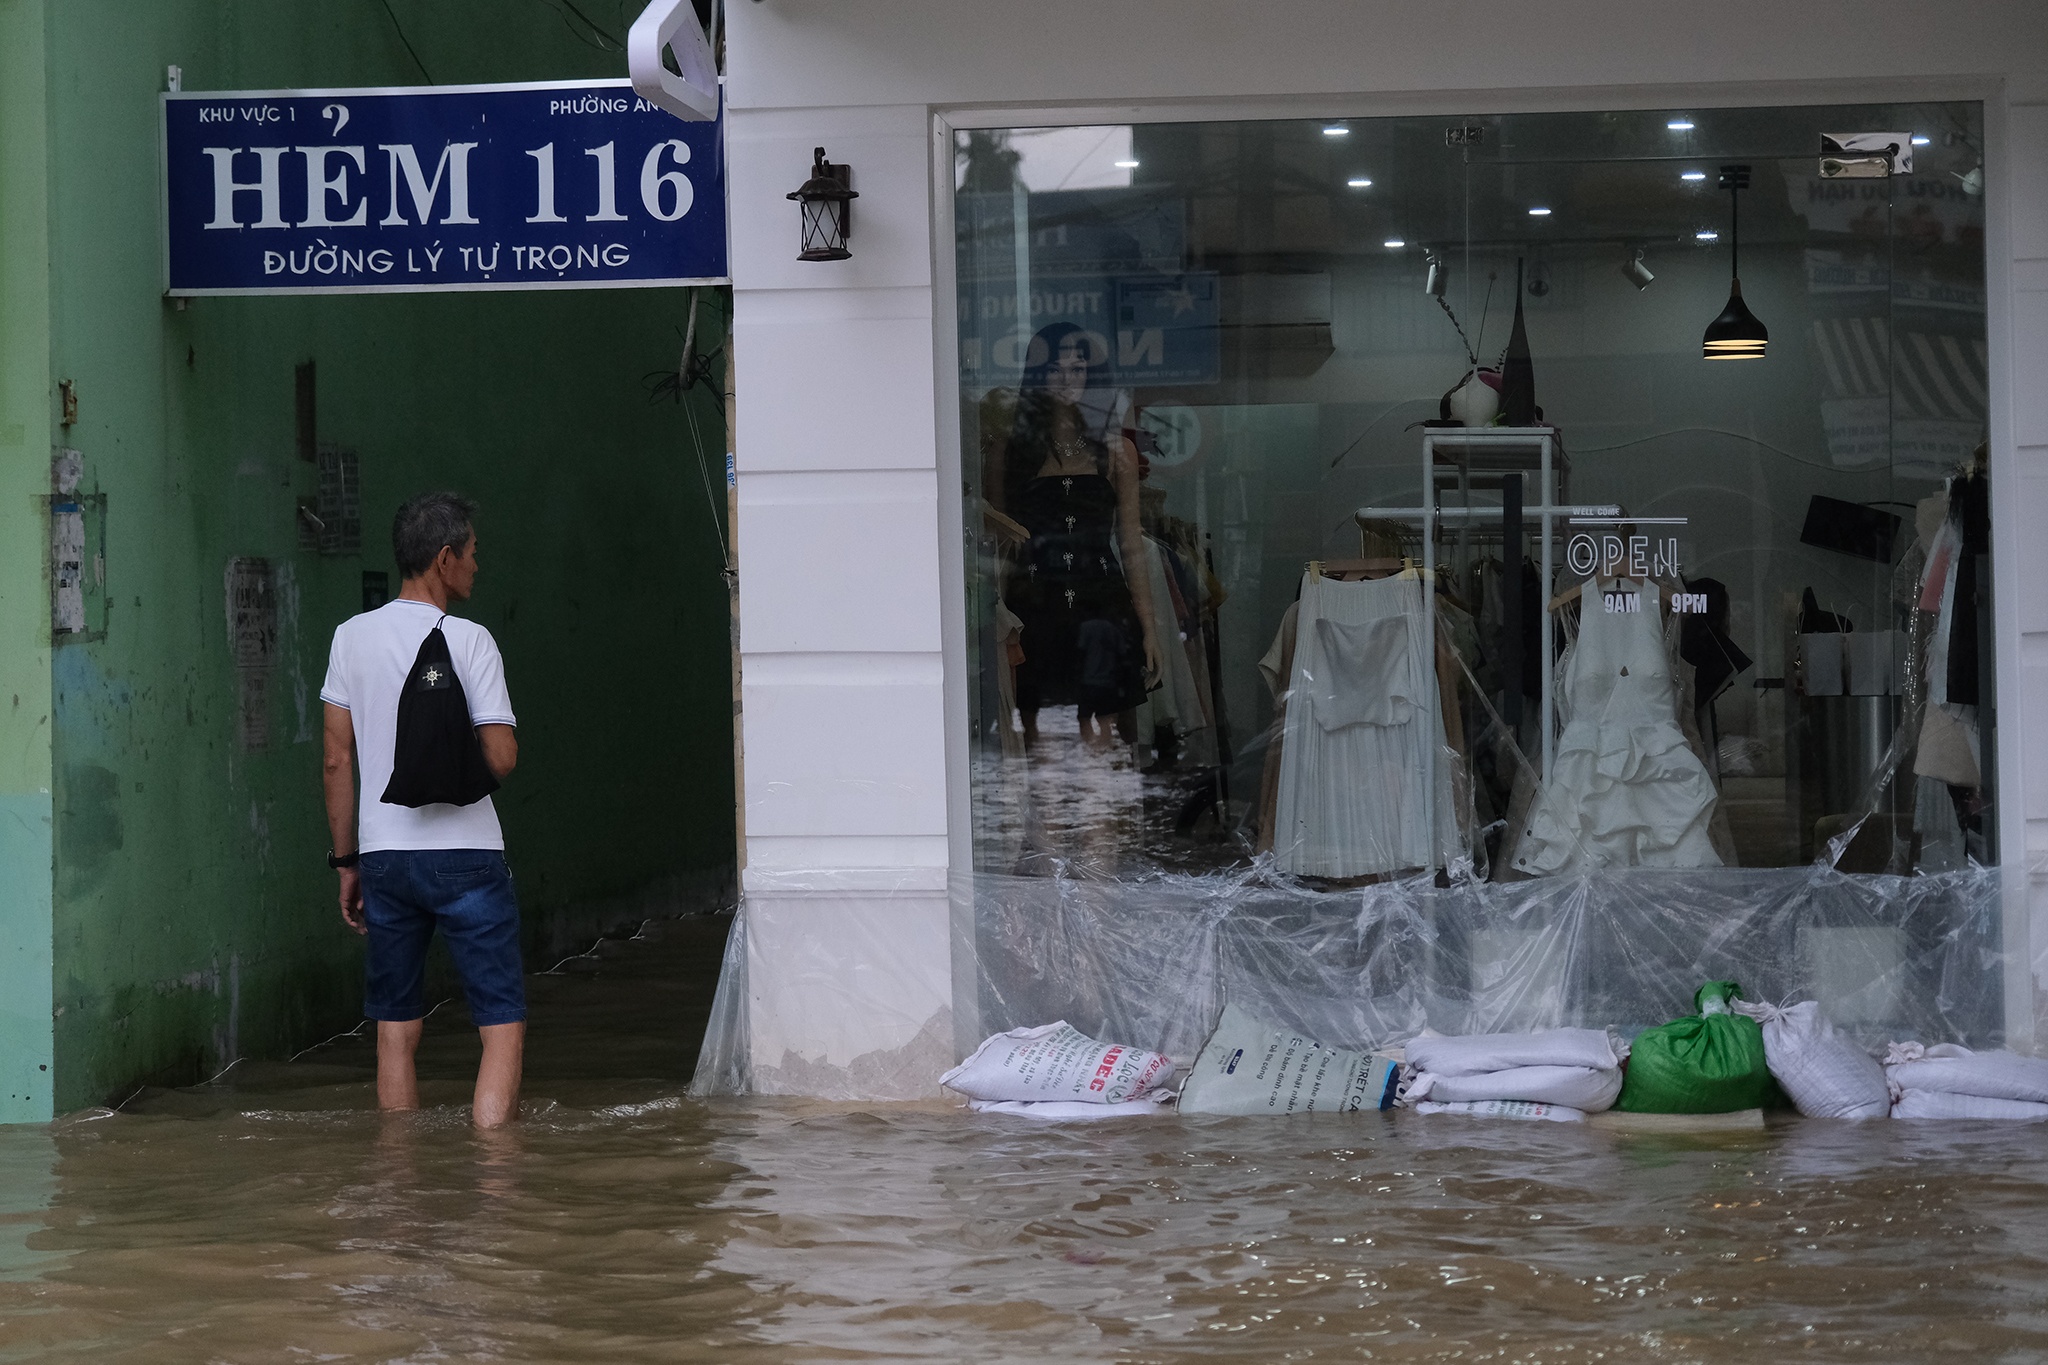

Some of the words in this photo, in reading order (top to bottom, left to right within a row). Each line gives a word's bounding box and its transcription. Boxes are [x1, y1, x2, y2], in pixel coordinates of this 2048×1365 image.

[199, 106, 235, 124] KHU
[241, 104, 281, 126] VỰC
[289, 106, 296, 122] 1
[550, 93, 628, 116] PHƯỜNG
[200, 104, 480, 241] HẺM
[525, 139, 695, 223] 116
[263, 238, 395, 276] ĐƯỜNG
[407, 239, 444, 274] LÝ
[459, 241, 501, 279] TỰ
[511, 243, 631, 277] TRỌNG
[1573, 507, 1594, 516] WELL
[1597, 507, 1620, 516] COME
[1567, 533, 1679, 578] OPEN
[1604, 593, 1641, 614] 9AM
[1671, 593, 1708, 614] 9PM
[1268, 1091, 1278, 1107] cao
